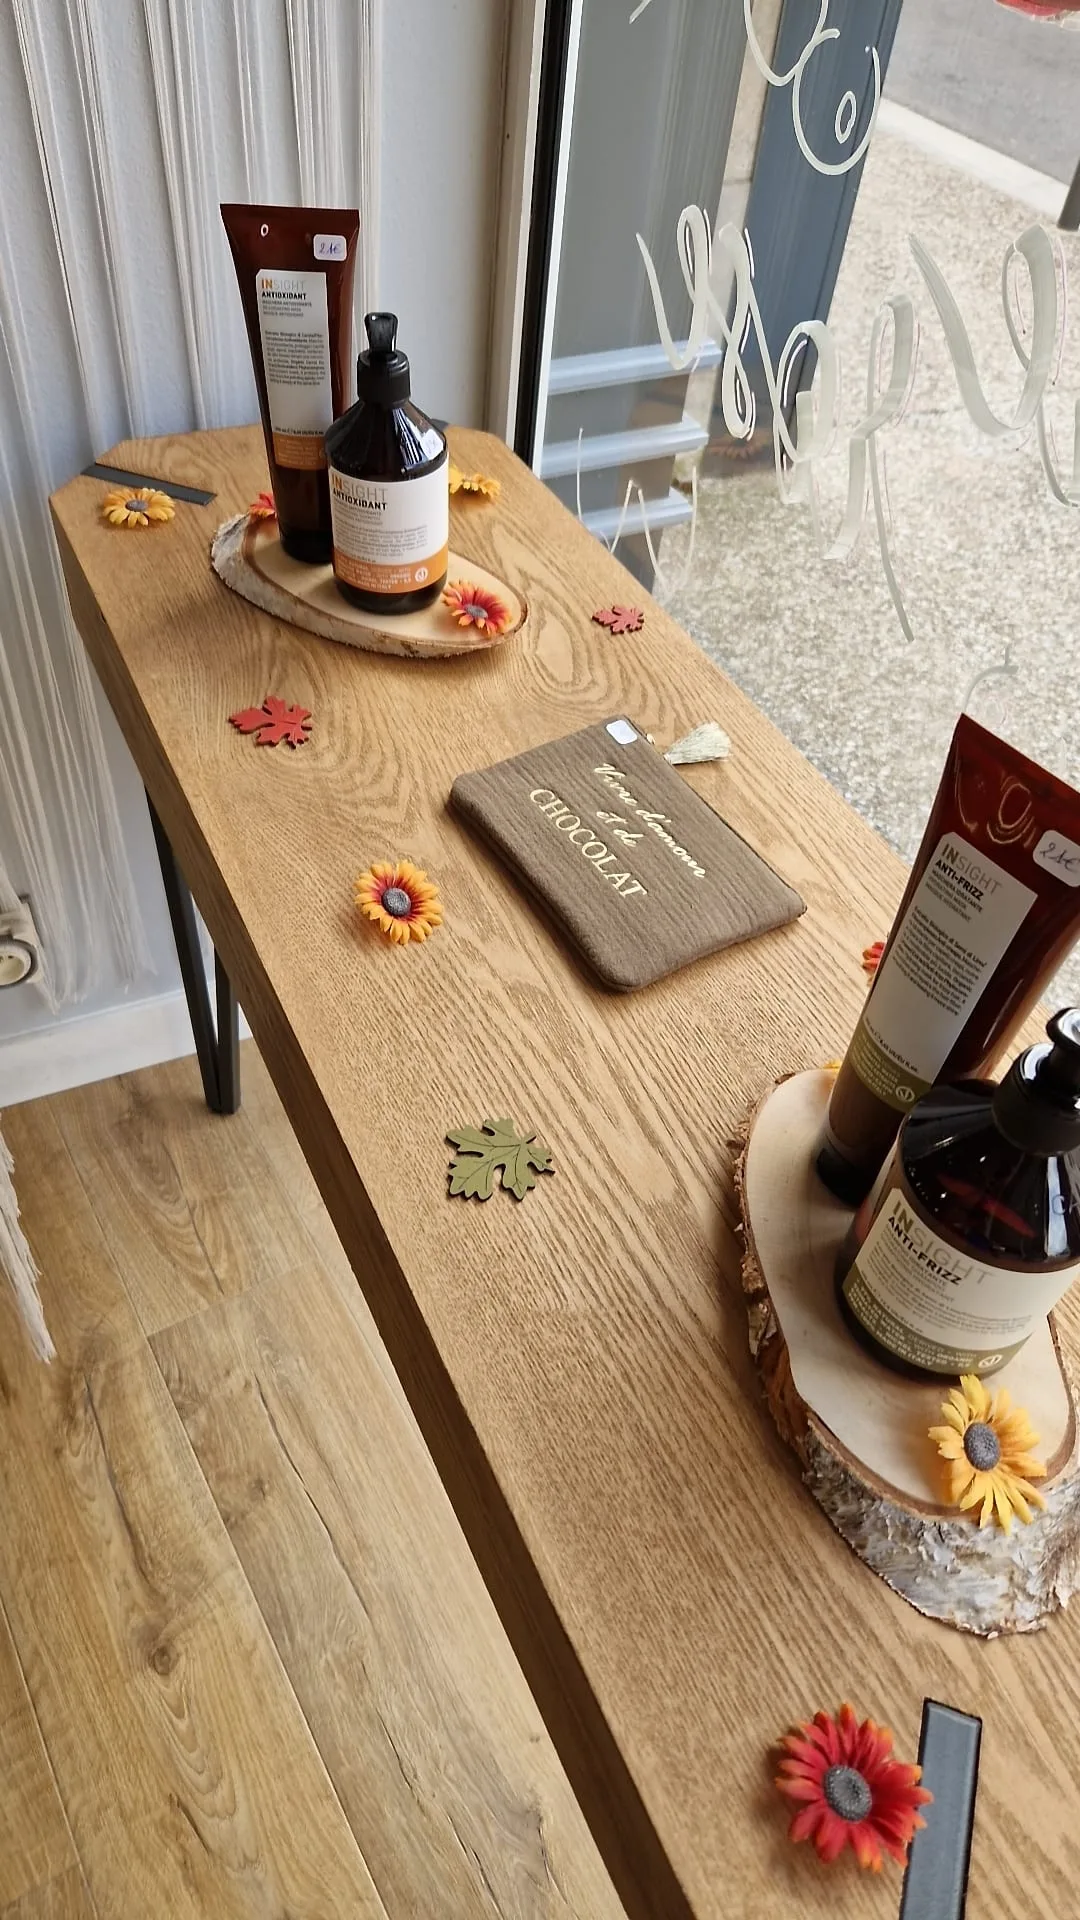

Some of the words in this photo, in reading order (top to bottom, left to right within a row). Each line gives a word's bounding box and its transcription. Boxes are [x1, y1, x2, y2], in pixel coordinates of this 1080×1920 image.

[261, 278, 306, 292] INSIGHT
[261, 291, 307, 301] ANTIOXIDANT
[331, 473, 389, 501] INSIGHT
[332, 488, 388, 511] ANTIOXIDANT
[529, 788, 648, 899] CHOCOLAT
[596, 810, 629, 825] et
[613, 829, 644, 848] de
[935, 859, 984, 901] ANTI-FRIZZ
[941, 843, 1003, 896] INSIGHT
[888, 1216, 963, 1286] ANTI-FRIZZ
[892, 1201, 997, 1284] INSIGHT
